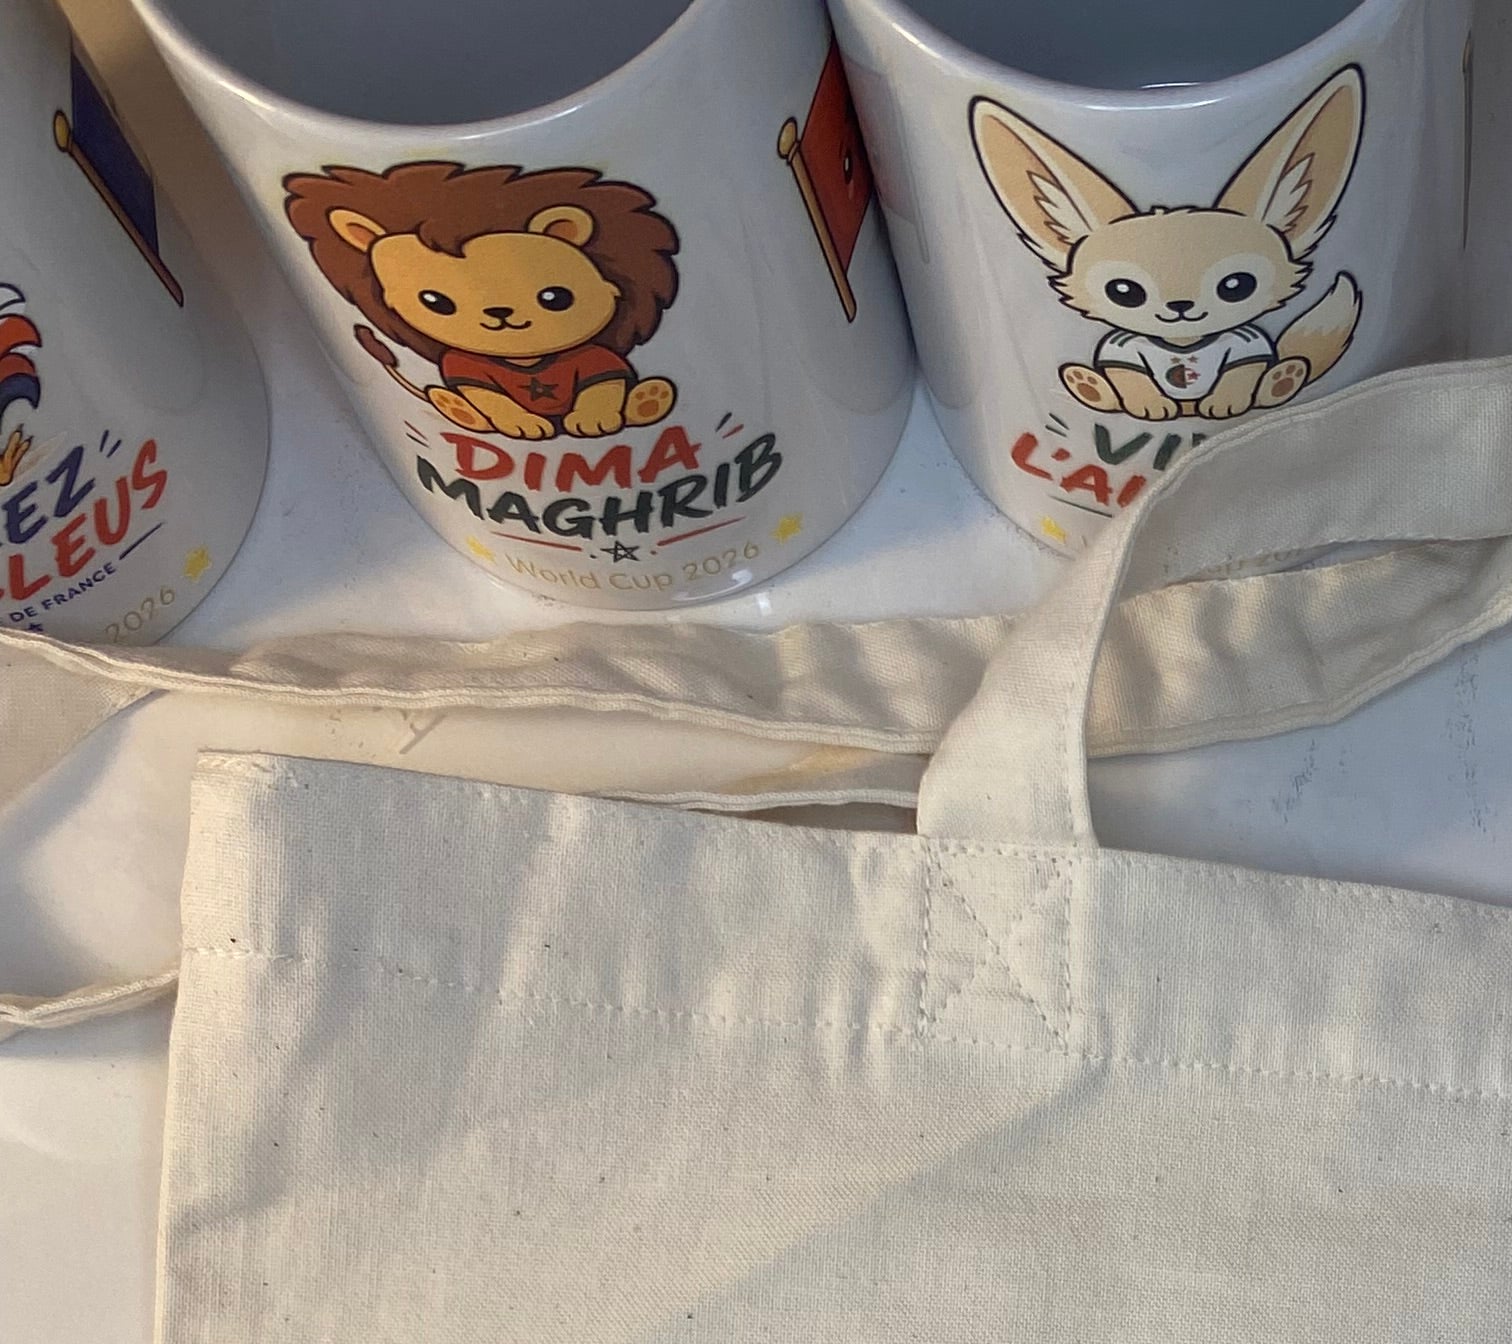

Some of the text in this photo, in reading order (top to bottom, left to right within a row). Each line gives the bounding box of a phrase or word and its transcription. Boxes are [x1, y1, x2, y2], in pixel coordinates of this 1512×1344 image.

[440, 425, 702, 492] DIMA
[1095, 423, 1206, 471] VI
[0, 446, 95, 545] EZ
[417, 433, 782, 539] MAGHRIB
[0, 439, 167, 600] LEUS
[9, 562, 116, 622] DE FRANCE
[506, 541, 760, 592] World Cup 2026
[105, 587, 175, 643] 2026
